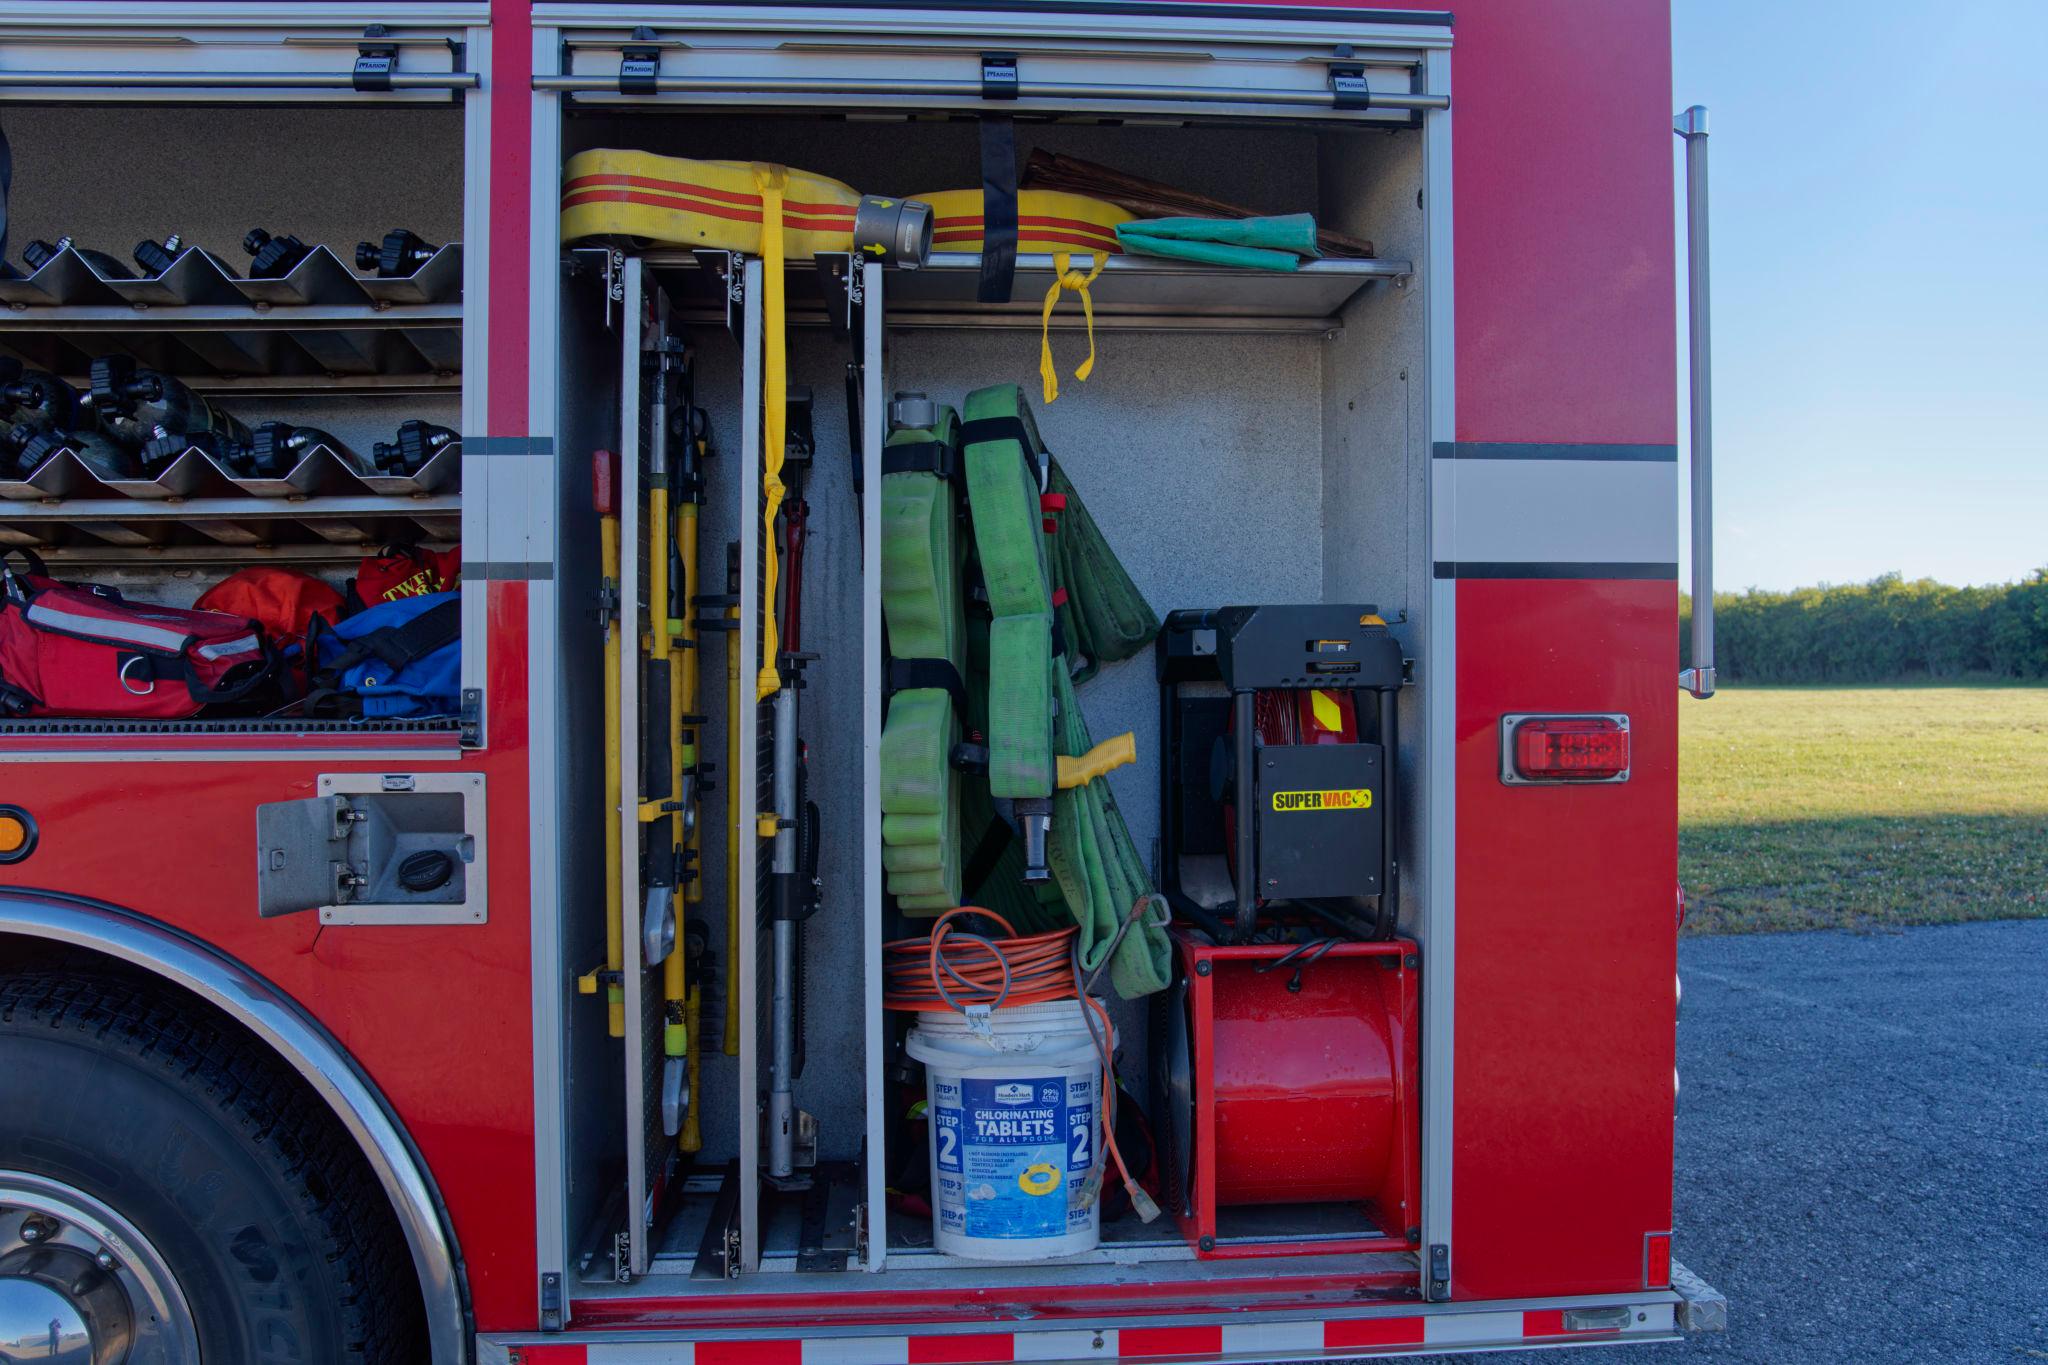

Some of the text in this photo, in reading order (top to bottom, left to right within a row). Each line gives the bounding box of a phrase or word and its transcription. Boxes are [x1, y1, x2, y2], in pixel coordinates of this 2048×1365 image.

[935, 1083, 958, 1095] STEP 1
[1070, 1082, 1088, 1092] STEP
[936, 1114, 959, 1127] STEP
[974, 1109, 1054, 1120] CHLORINATING
[1069, 1112, 1091, 1125] STEP
[975, 1120, 1055, 1136] TABLETS
[939, 1127, 958, 1165] 2
[1072, 1125, 1089, 1163] 2
[940, 1178, 962, 1191] STEP 3
[941, 1208, 957, 1220] STEP
